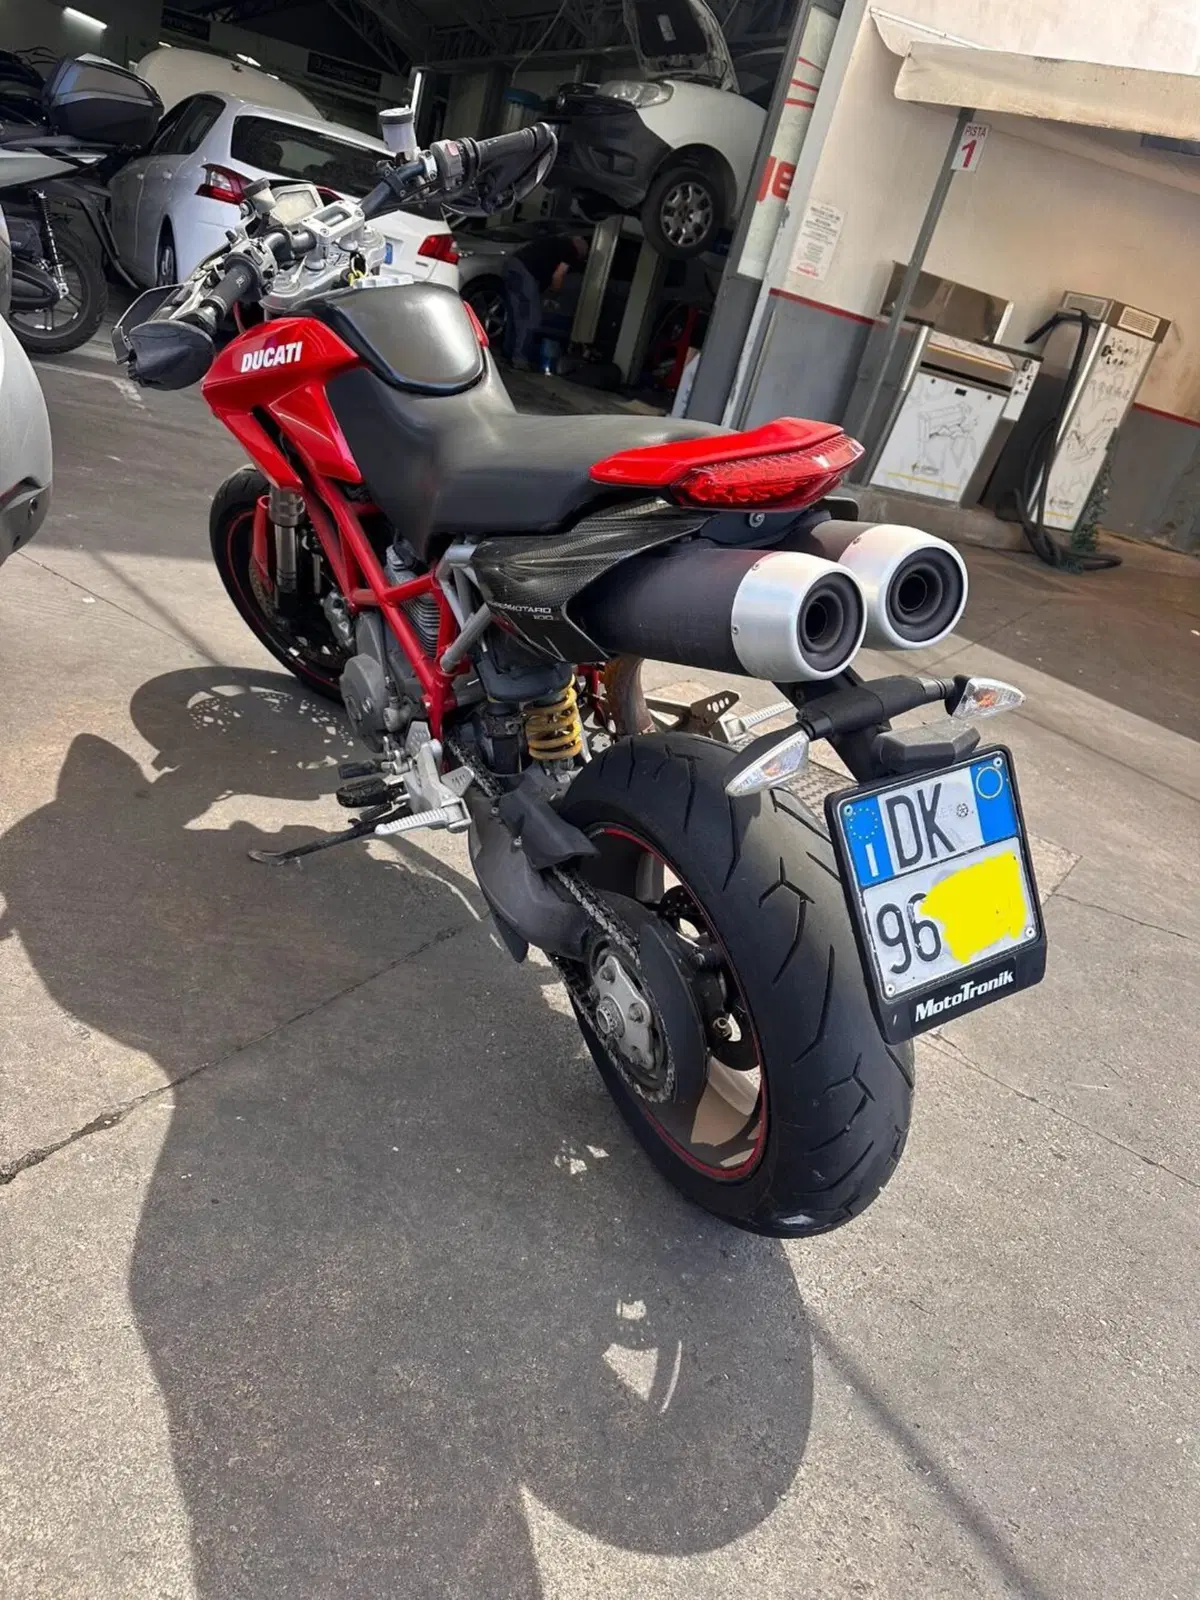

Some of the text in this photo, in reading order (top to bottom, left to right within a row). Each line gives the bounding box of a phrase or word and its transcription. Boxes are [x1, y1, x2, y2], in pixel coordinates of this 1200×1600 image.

[965, 125, 987, 138] PISTA
[961, 139, 977, 168] 1
[241, 341, 303, 373] DUCATI
[885, 782, 956, 869] DK
[865, 843, 880, 877] I
[914, 970, 1014, 1022] MotoTronik
